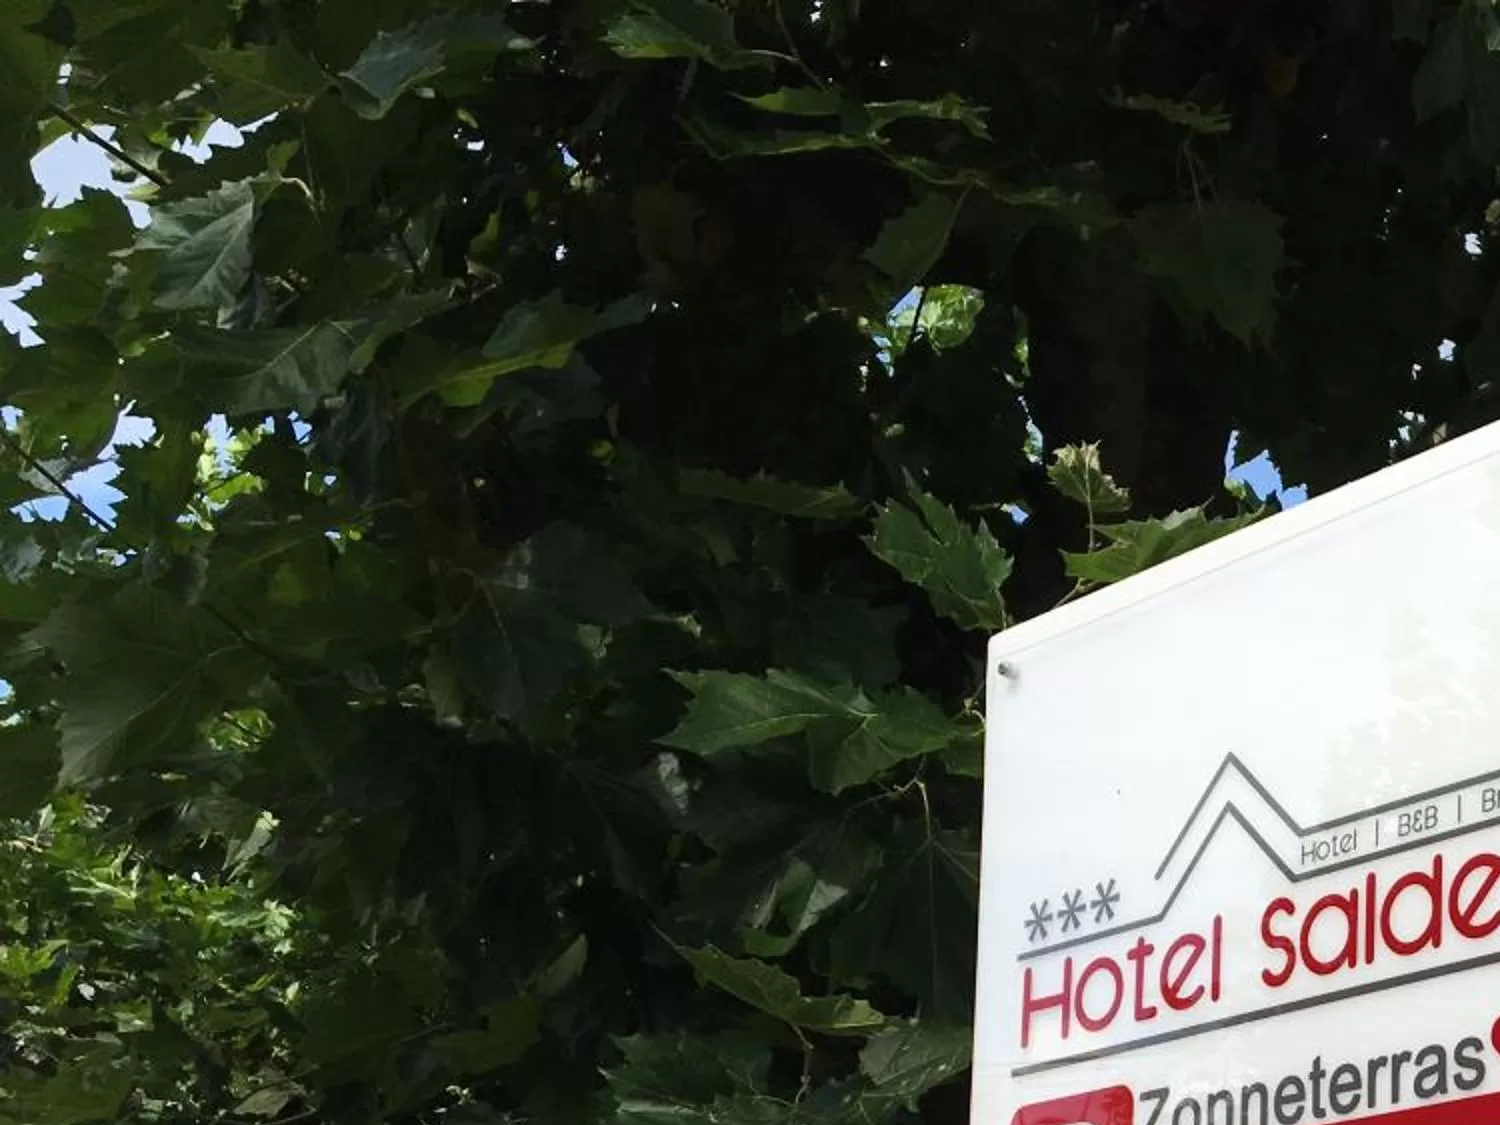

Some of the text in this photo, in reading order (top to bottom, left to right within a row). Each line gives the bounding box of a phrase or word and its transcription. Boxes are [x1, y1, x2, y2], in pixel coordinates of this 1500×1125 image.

[1300, 828, 1358, 866] Hotel
[1397, 804, 1439, 838] B&B
[1020, 915, 1223, 1048] Hotel
